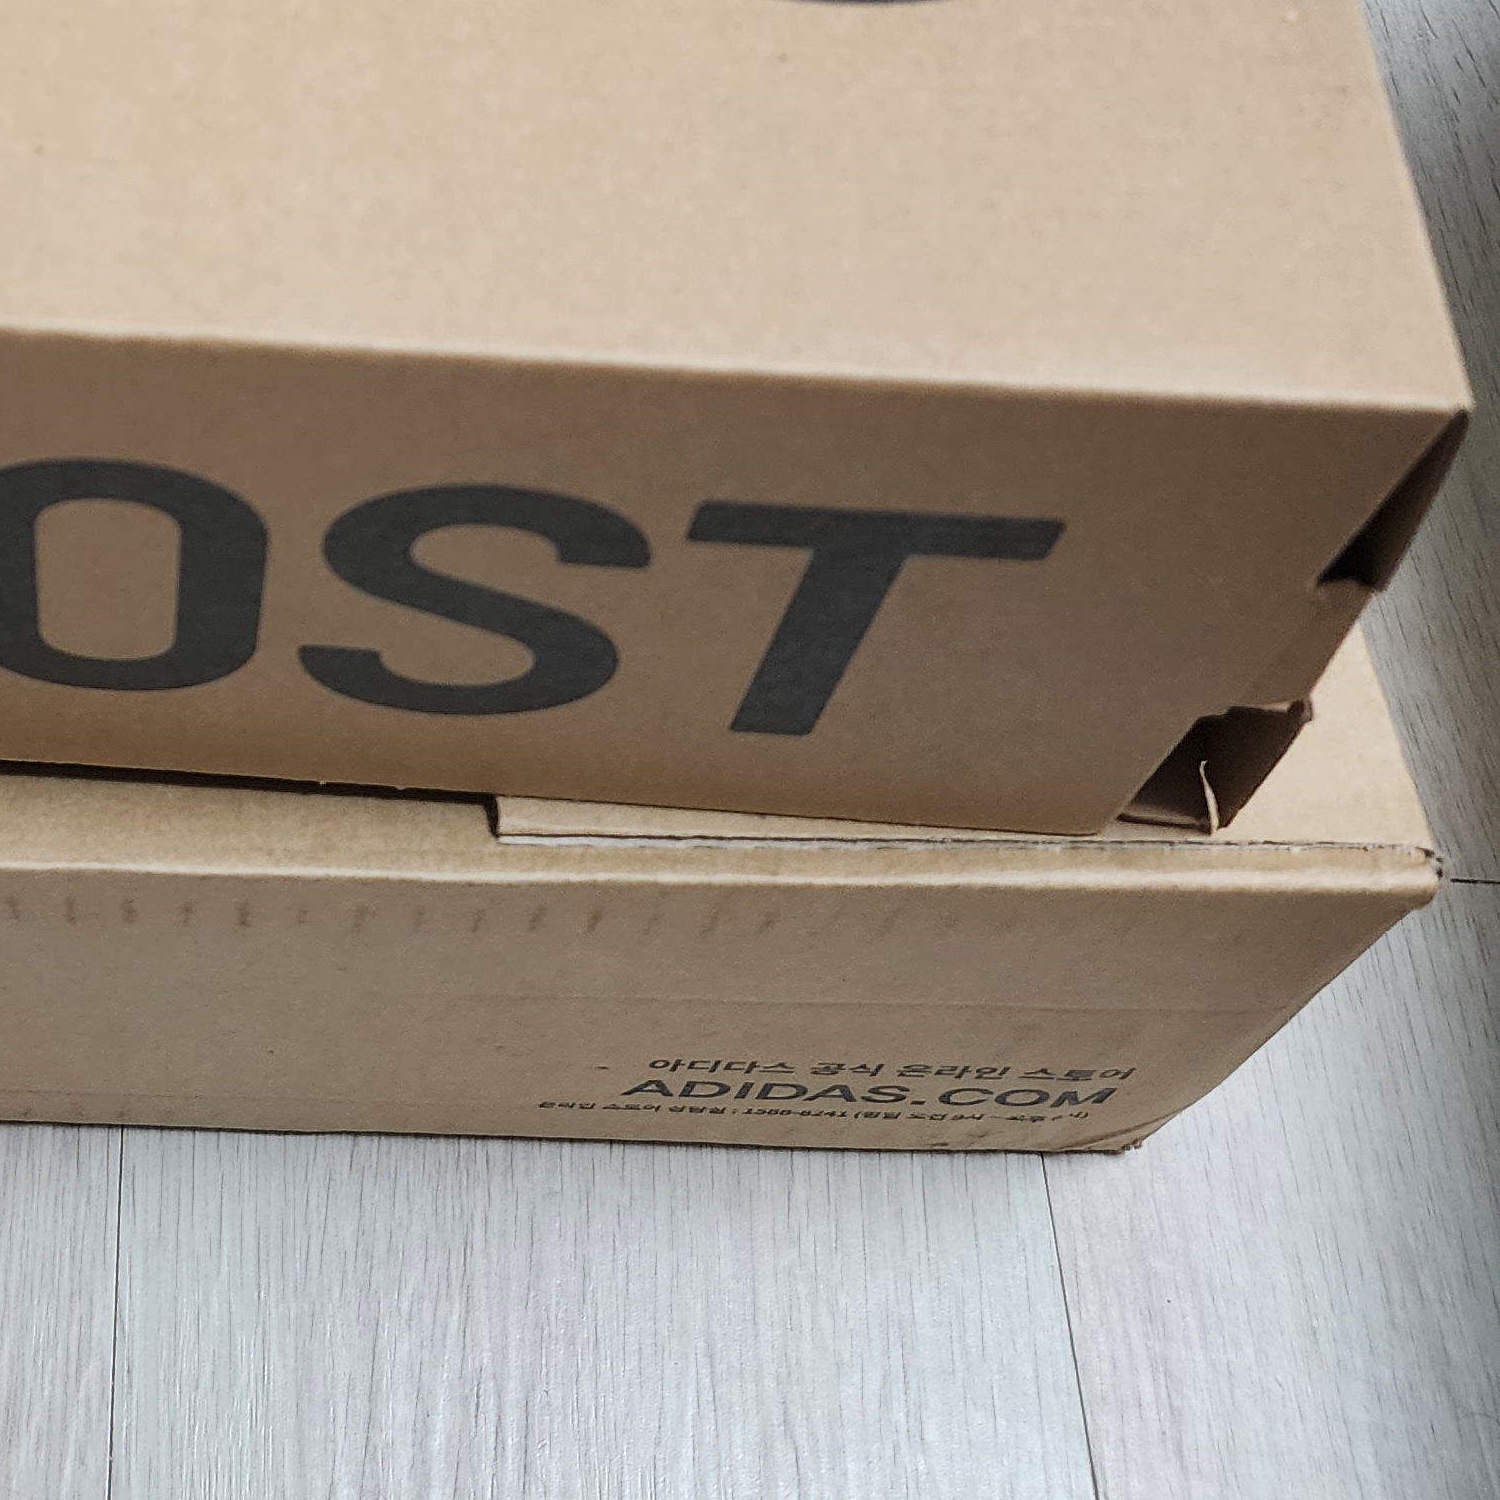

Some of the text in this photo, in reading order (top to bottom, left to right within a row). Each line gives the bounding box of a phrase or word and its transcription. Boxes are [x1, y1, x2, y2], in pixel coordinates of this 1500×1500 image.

[648, 1058, 1137, 1082] 아디다스 공식 온라인 스토어
[619, 1078, 1118, 1108] ADIDAS.COM
